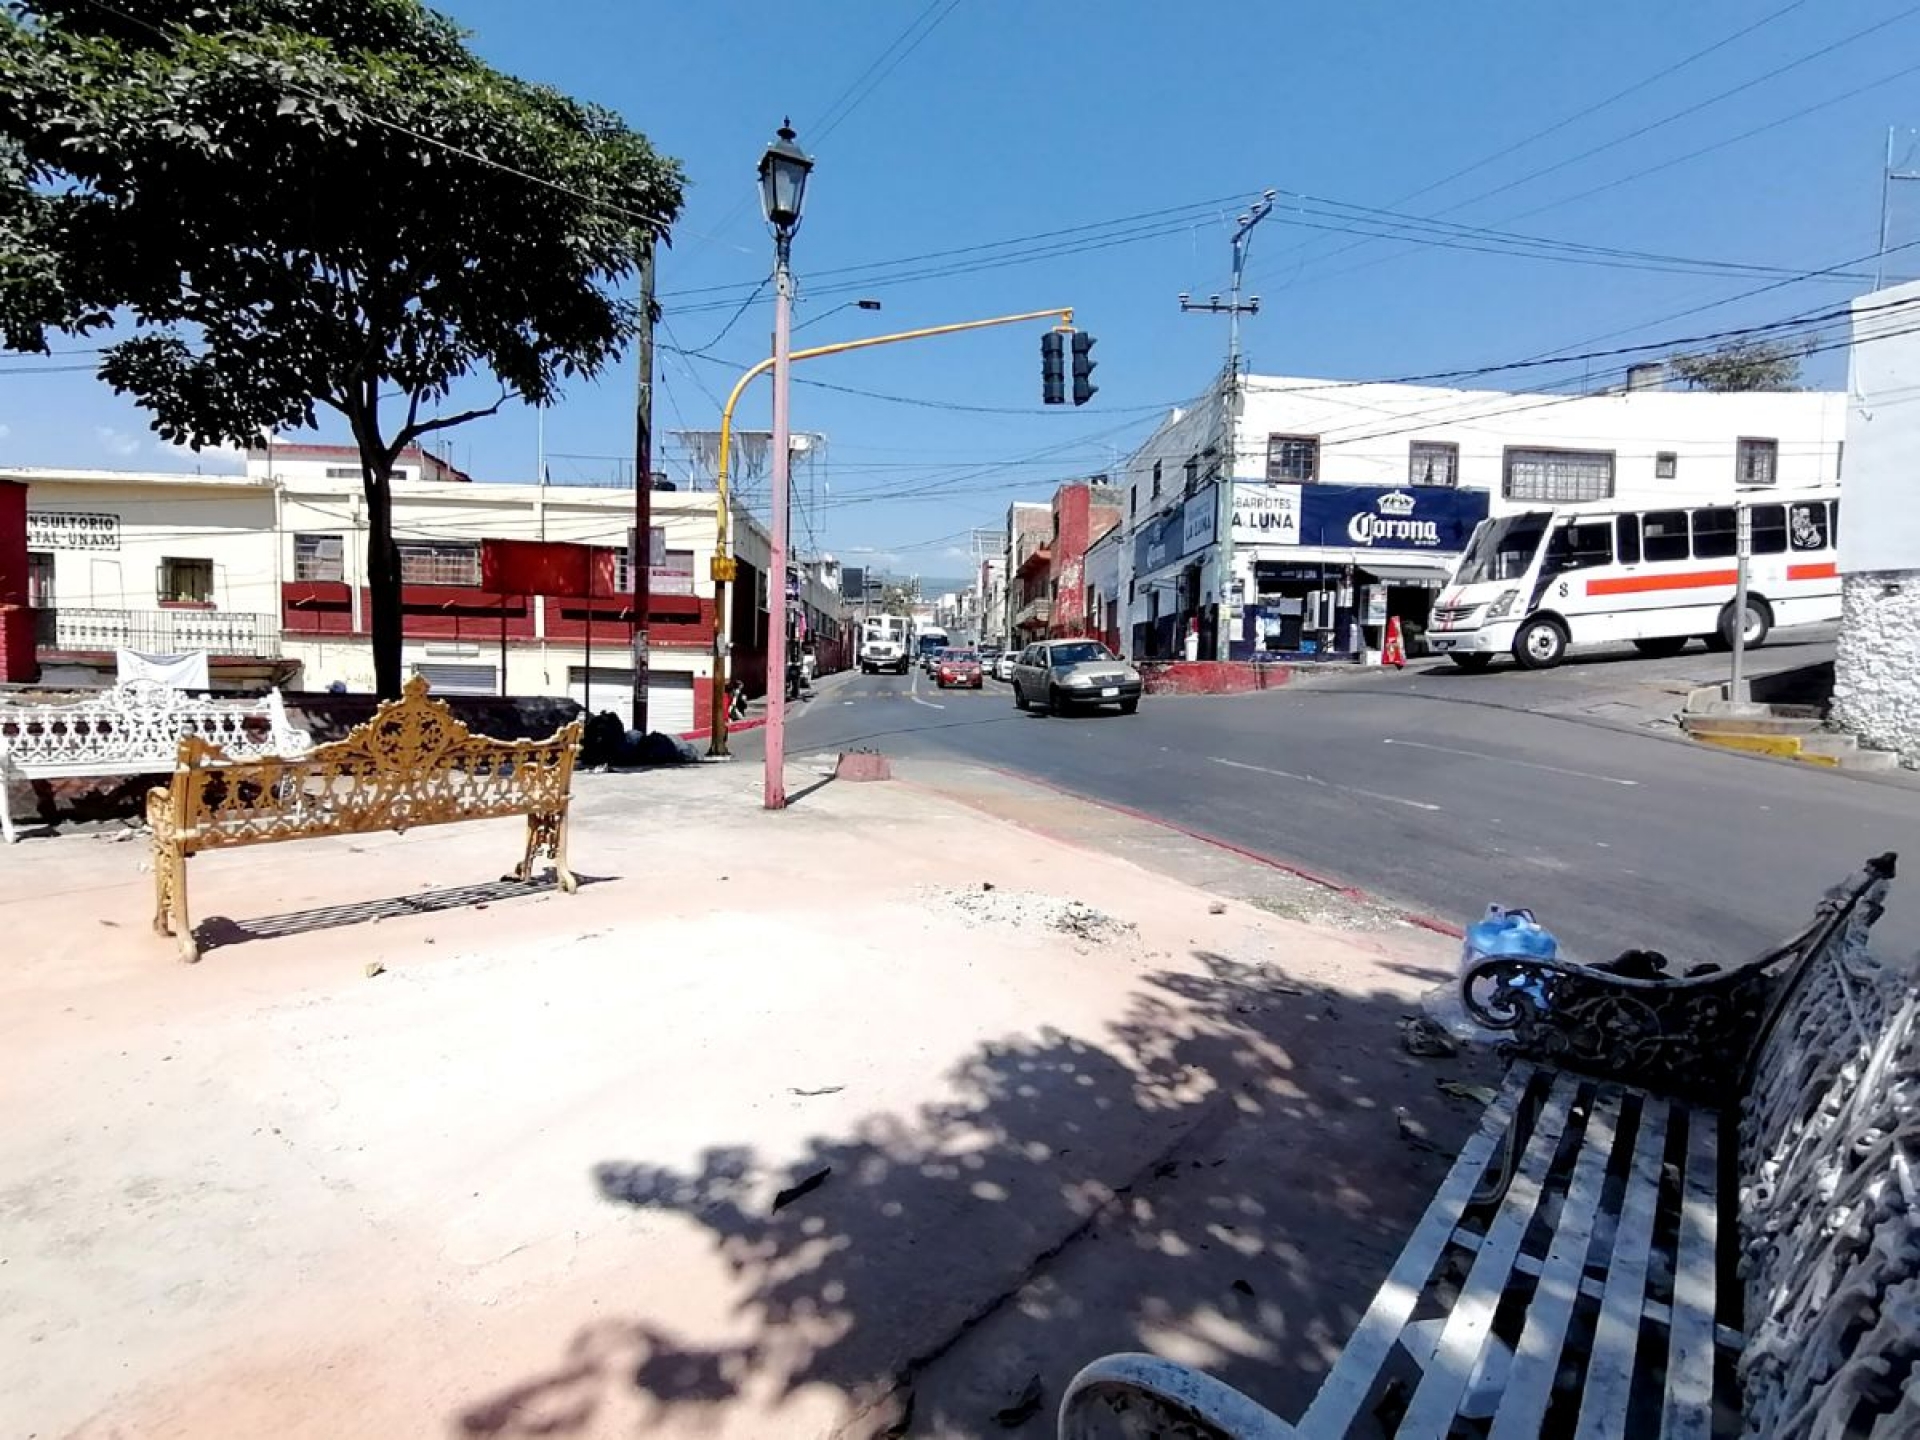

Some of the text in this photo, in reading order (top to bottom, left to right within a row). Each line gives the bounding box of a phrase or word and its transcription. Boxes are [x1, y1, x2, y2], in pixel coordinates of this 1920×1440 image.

[1250, 512, 1294, 529] LUNA
[1347, 511, 1440, 546] Corona
[1559, 581, 1569, 598] 8
